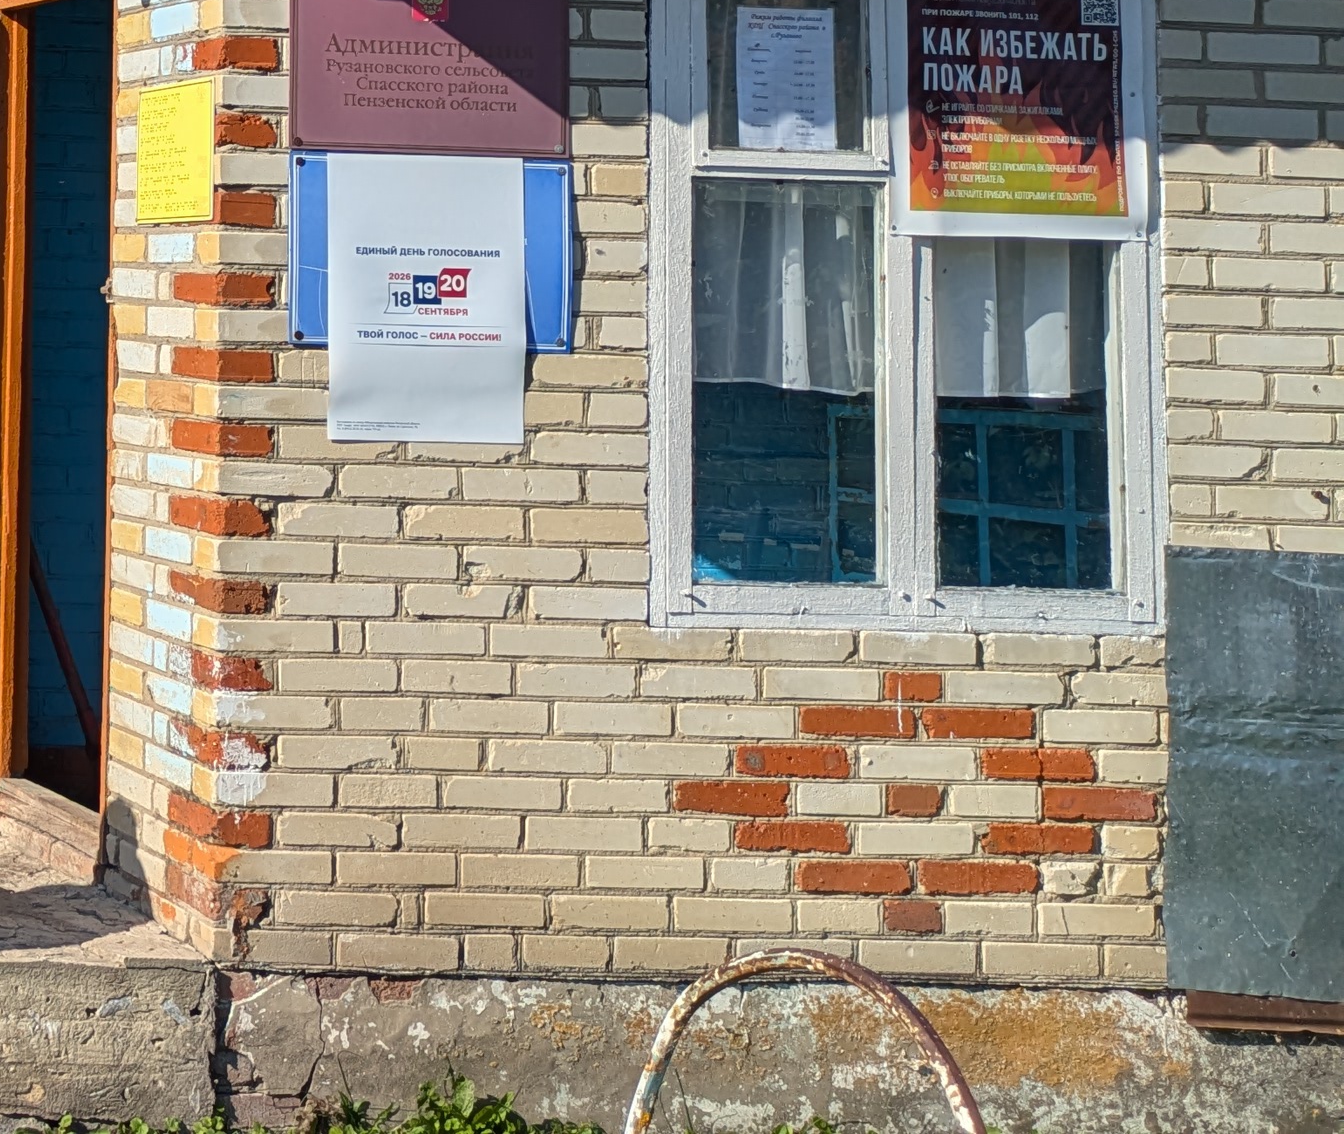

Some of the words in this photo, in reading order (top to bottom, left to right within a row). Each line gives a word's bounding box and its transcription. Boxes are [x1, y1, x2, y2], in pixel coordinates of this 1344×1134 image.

[922, 8, 938, 16] ПРИ
[940, 9, 973, 17] ПОЖАРЕ
[975, 10, 1007, 19] ЗВОНИТЬ
[1009, 12, 1023, 20] 101,
[325, 33, 534, 62] Администрация
[922, 26, 971, 56] КАК
[981, 28, 1107, 61] ИЗБЕЖАТЬ
[326, 59, 440, 76] Рузановского
[445, 65, 534, 79] сельсовета
[923, 62, 1023, 95] ПОЖАРА
[356, 76, 443, 92] Спасского
[448, 81, 509, 96] района
[344, 93, 446, 110] Пензенской
[450, 97, 517, 112] области
[942, 103, 950, 111] НЕ
[942, 132, 950, 140] НЕ
[942, 144, 972, 153] ПРИБОРОВ
[943, 161, 950, 170] НЕ
[990, 163, 1002, 171] БЕЗ
[960, 174, 1005, 183] ОБОГРЕВАТЕЛЬ
[1047, 192, 1055, 200] НЕ
[356, 246, 397, 255] ЕДИНЫЙ
[399, 247, 425, 256] ДЕНЬ
[428, 248, 500, 257] ГОЛОСОВАНИЯ
[392, 291, 412, 307] 18
[415, 282, 436, 299] 19
[440, 274, 465, 292] 20
[418, 307, 468, 316] СЕНТЯБРЯ
[357, 329, 384, 338] ТВОЙ
[386, 331, 419, 339] ГОЛОС
[429, 332, 456, 341] СИЛА
[459, 333, 501, 342] РОССИИ!
